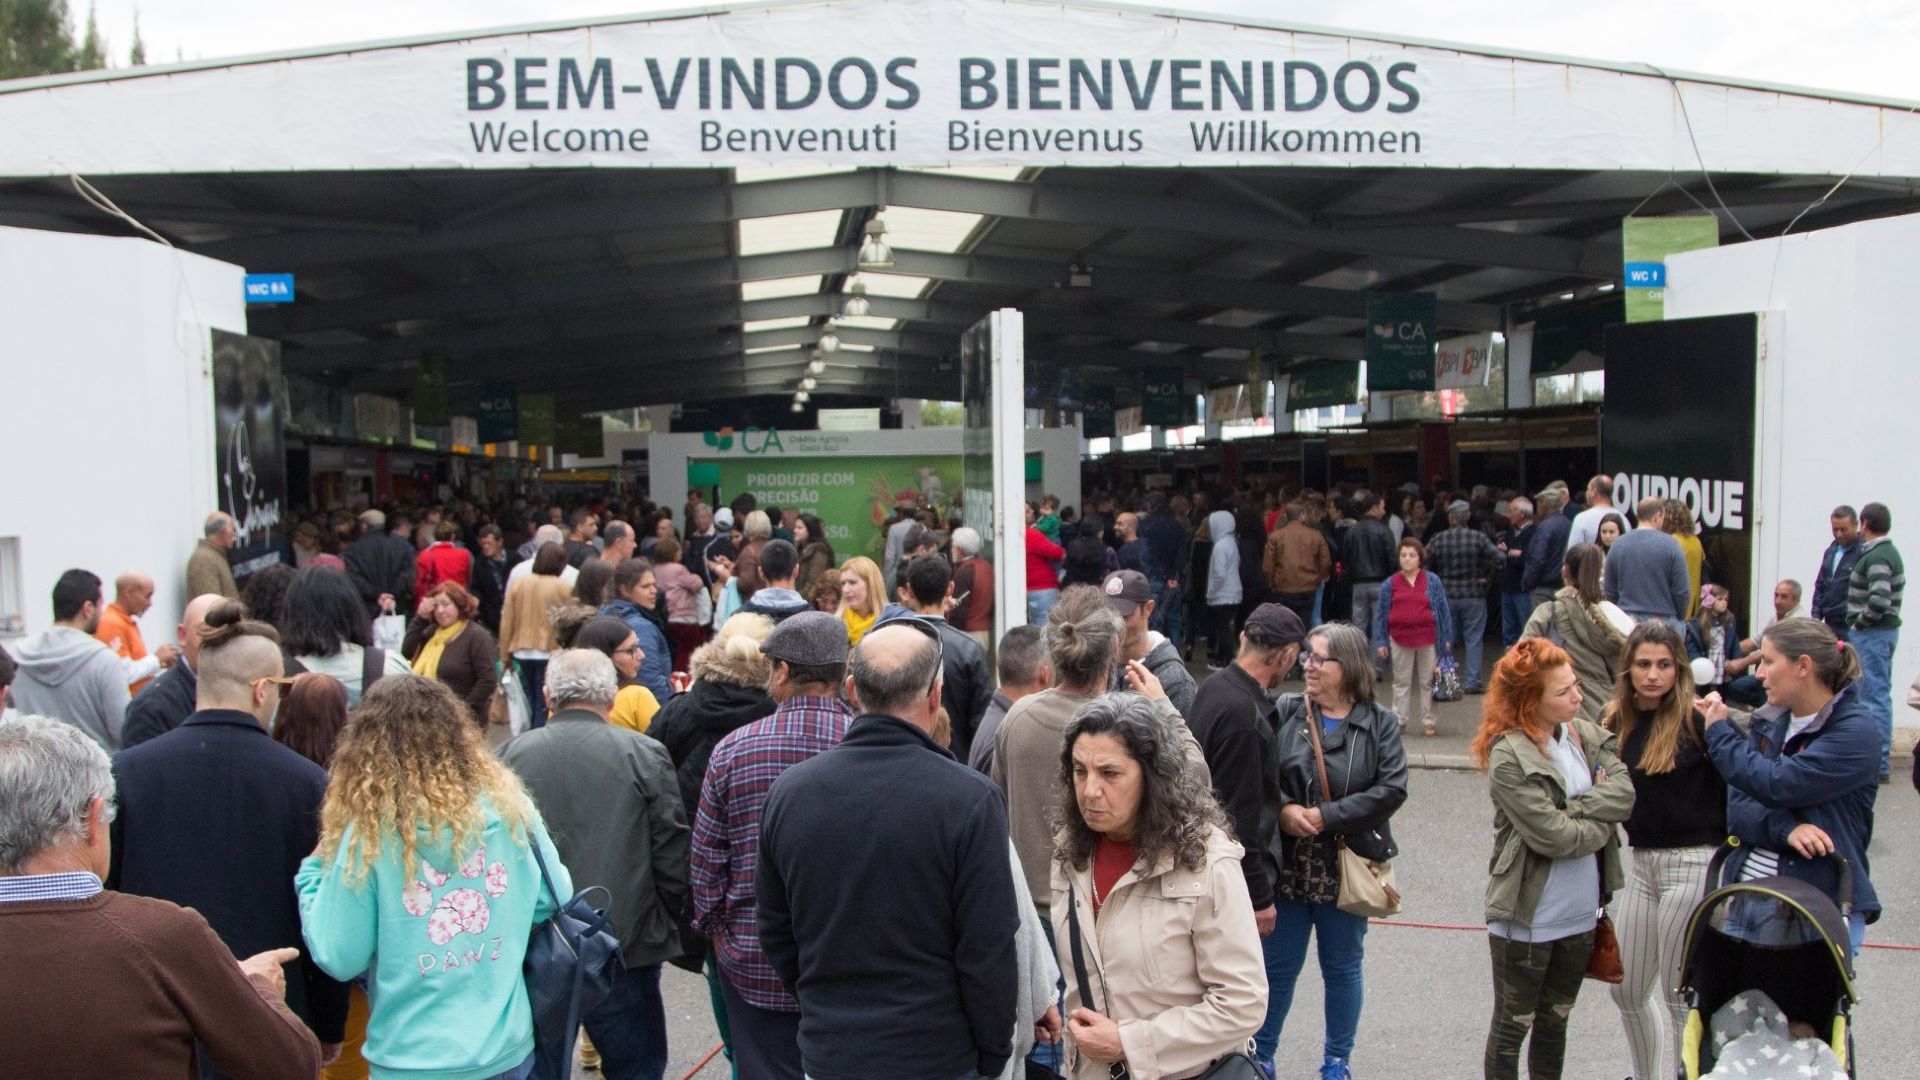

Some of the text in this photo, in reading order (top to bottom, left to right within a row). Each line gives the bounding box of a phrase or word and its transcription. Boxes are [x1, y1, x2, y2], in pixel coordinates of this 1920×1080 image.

[466, 57, 1421, 113] BEM-VINDOS BIENVENIDOS
[470, 119, 1421, 153] Welcome Benvenuti Bienvenus Willkommen
[1631, 270, 1649, 281] WC
[246, 283, 270, 296] WC
[1398, 321, 1427, 340] CA
[741, 426, 785, 453] CA
[747, 472, 855, 486] PRODUZIR COM
[419, 937, 503, 976] PAWZ
